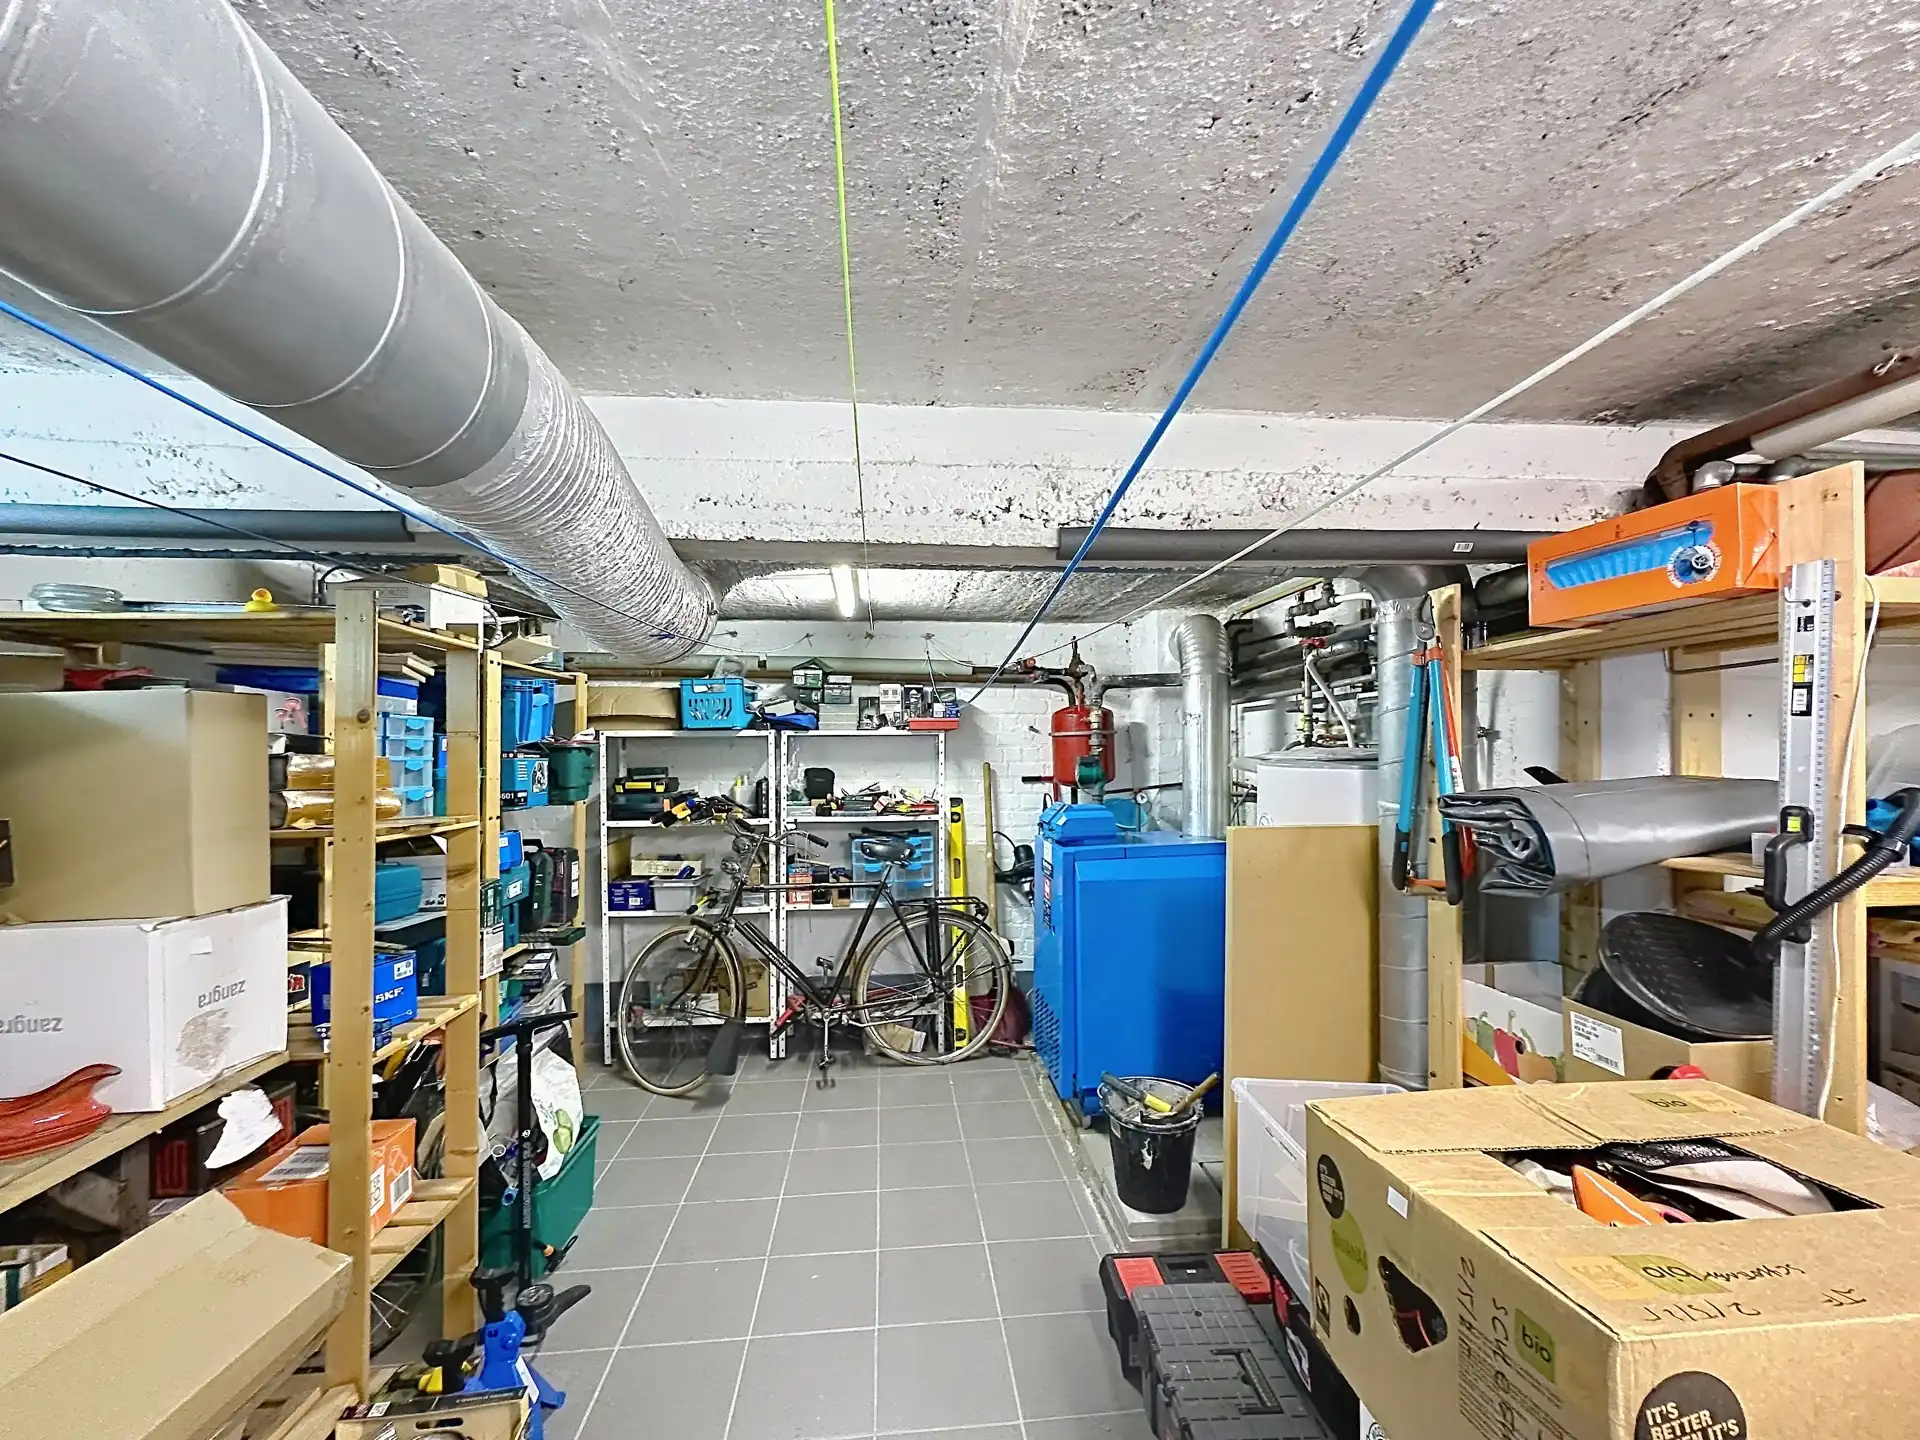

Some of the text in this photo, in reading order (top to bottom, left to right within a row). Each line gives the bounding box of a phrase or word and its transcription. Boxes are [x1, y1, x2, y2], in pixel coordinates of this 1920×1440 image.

[198, 979, 247, 1009] zangra
[375, 986, 404, 1004] SKF
[1647, 1098, 1688, 1108] bio
[1641, 1265, 1704, 1283] bio
[1521, 1324, 1552, 1363] bio
[1645, 1401, 1679, 1426] IT'S
[1650, 1409, 1713, 1440] BETTER
[1707, 1418, 1740, 1440] IT'S
